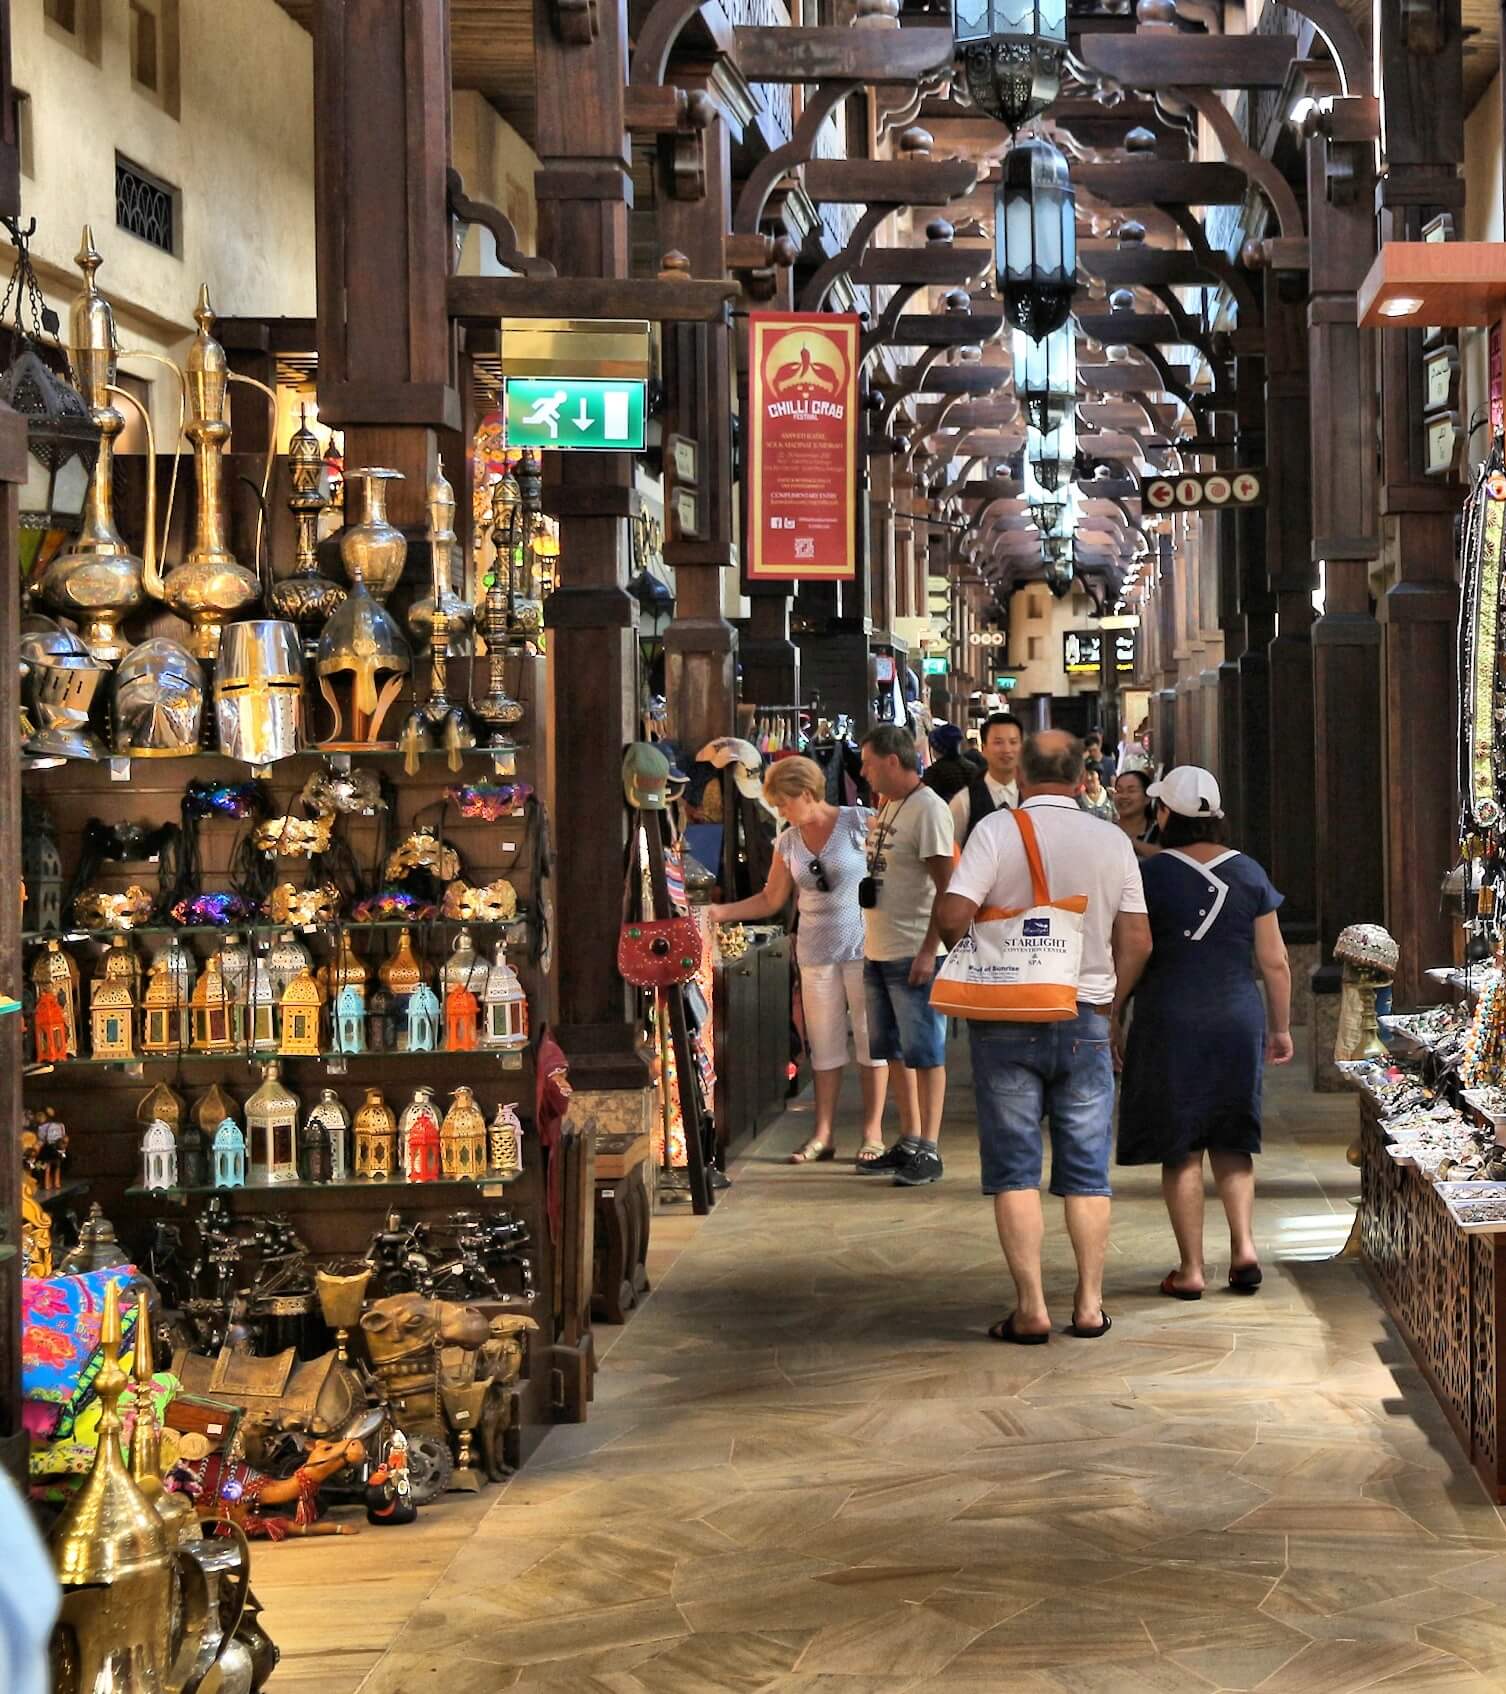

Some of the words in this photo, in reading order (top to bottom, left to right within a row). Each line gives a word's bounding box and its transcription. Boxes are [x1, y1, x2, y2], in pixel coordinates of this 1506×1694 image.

[767, 400, 808, 418] CHILLI
[811, 399, 844, 420] CRAB
[1004, 938, 1067, 947] STARLIGHT
[992, 964, 1020, 972] Sunrise
